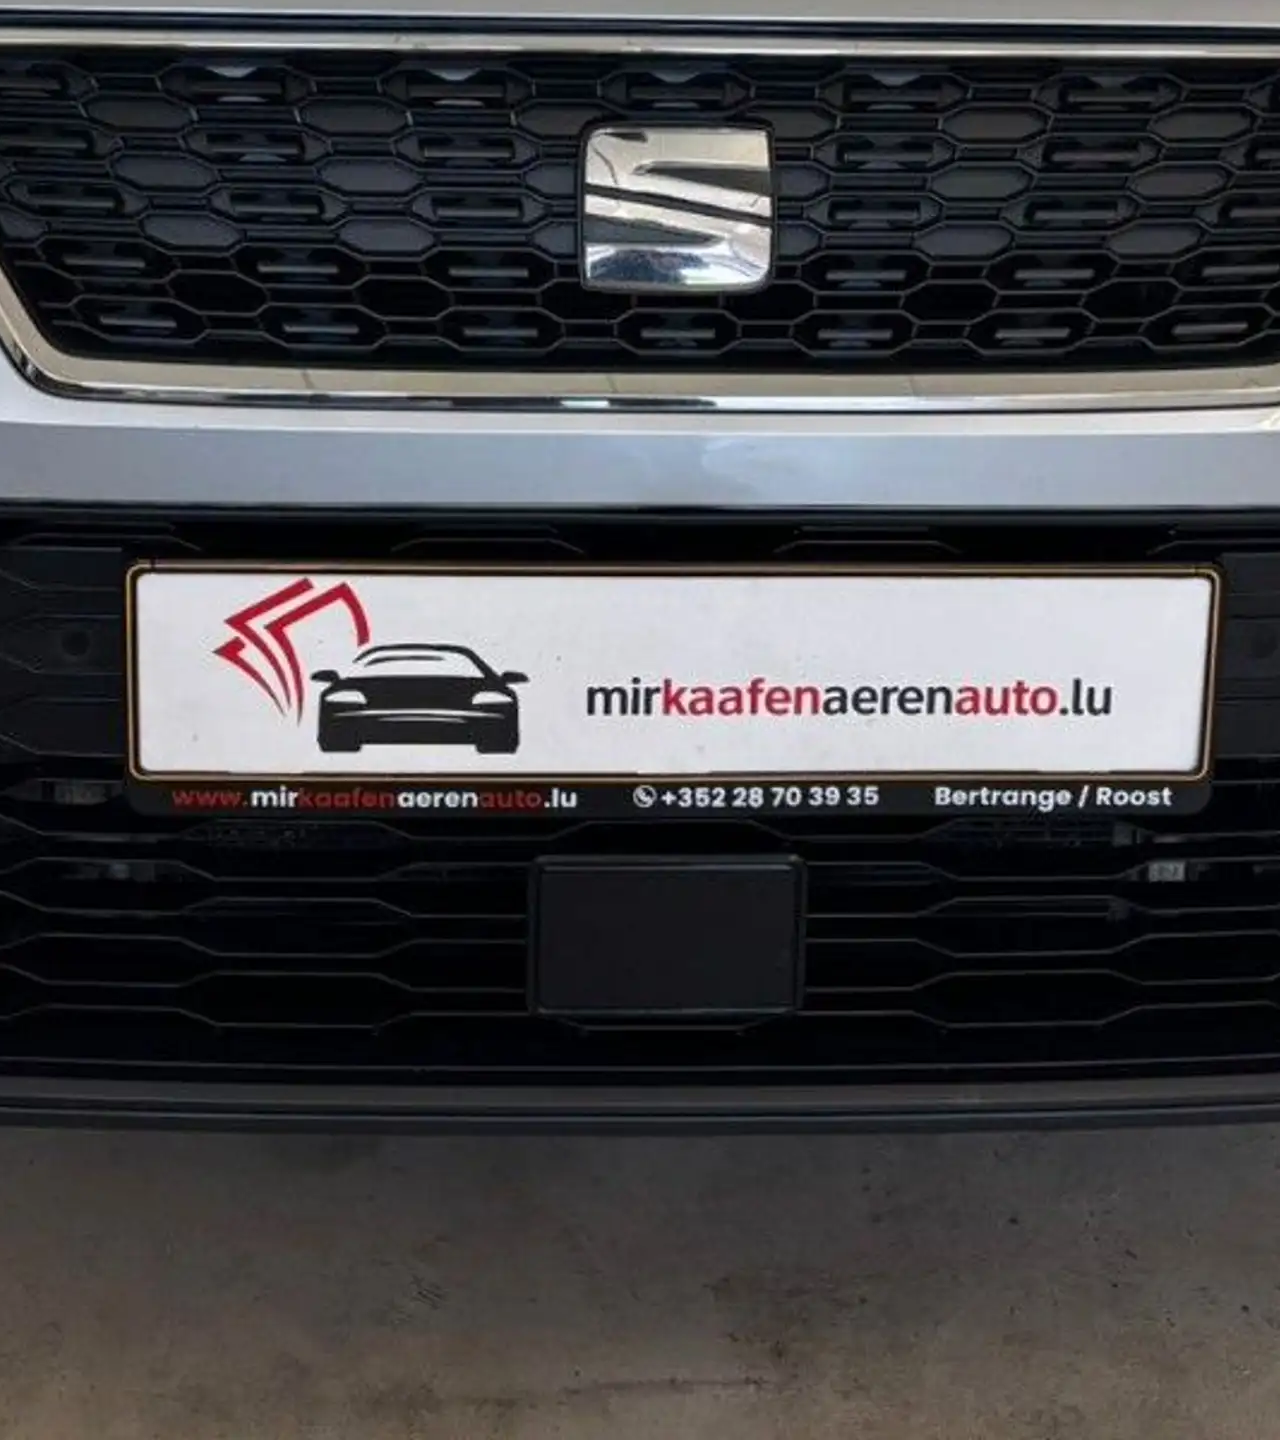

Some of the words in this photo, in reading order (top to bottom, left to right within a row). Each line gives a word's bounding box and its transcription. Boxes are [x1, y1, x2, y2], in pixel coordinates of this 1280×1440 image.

[586, 675, 1112, 717] mirkaafenaerenauto.lu
[171, 784, 578, 809] www.mirkaafenaerenauto.lu
[660, 786, 726, 808] +352
[731, 786, 764, 808] 28
[770, 786, 802, 808] 70
[807, 785, 840, 807] 39
[846, 785, 879, 807] 35
[934, 786, 1072, 812] Bertrange
[1077, 785, 1090, 808] /
[1095, 785, 1172, 807] Roost
